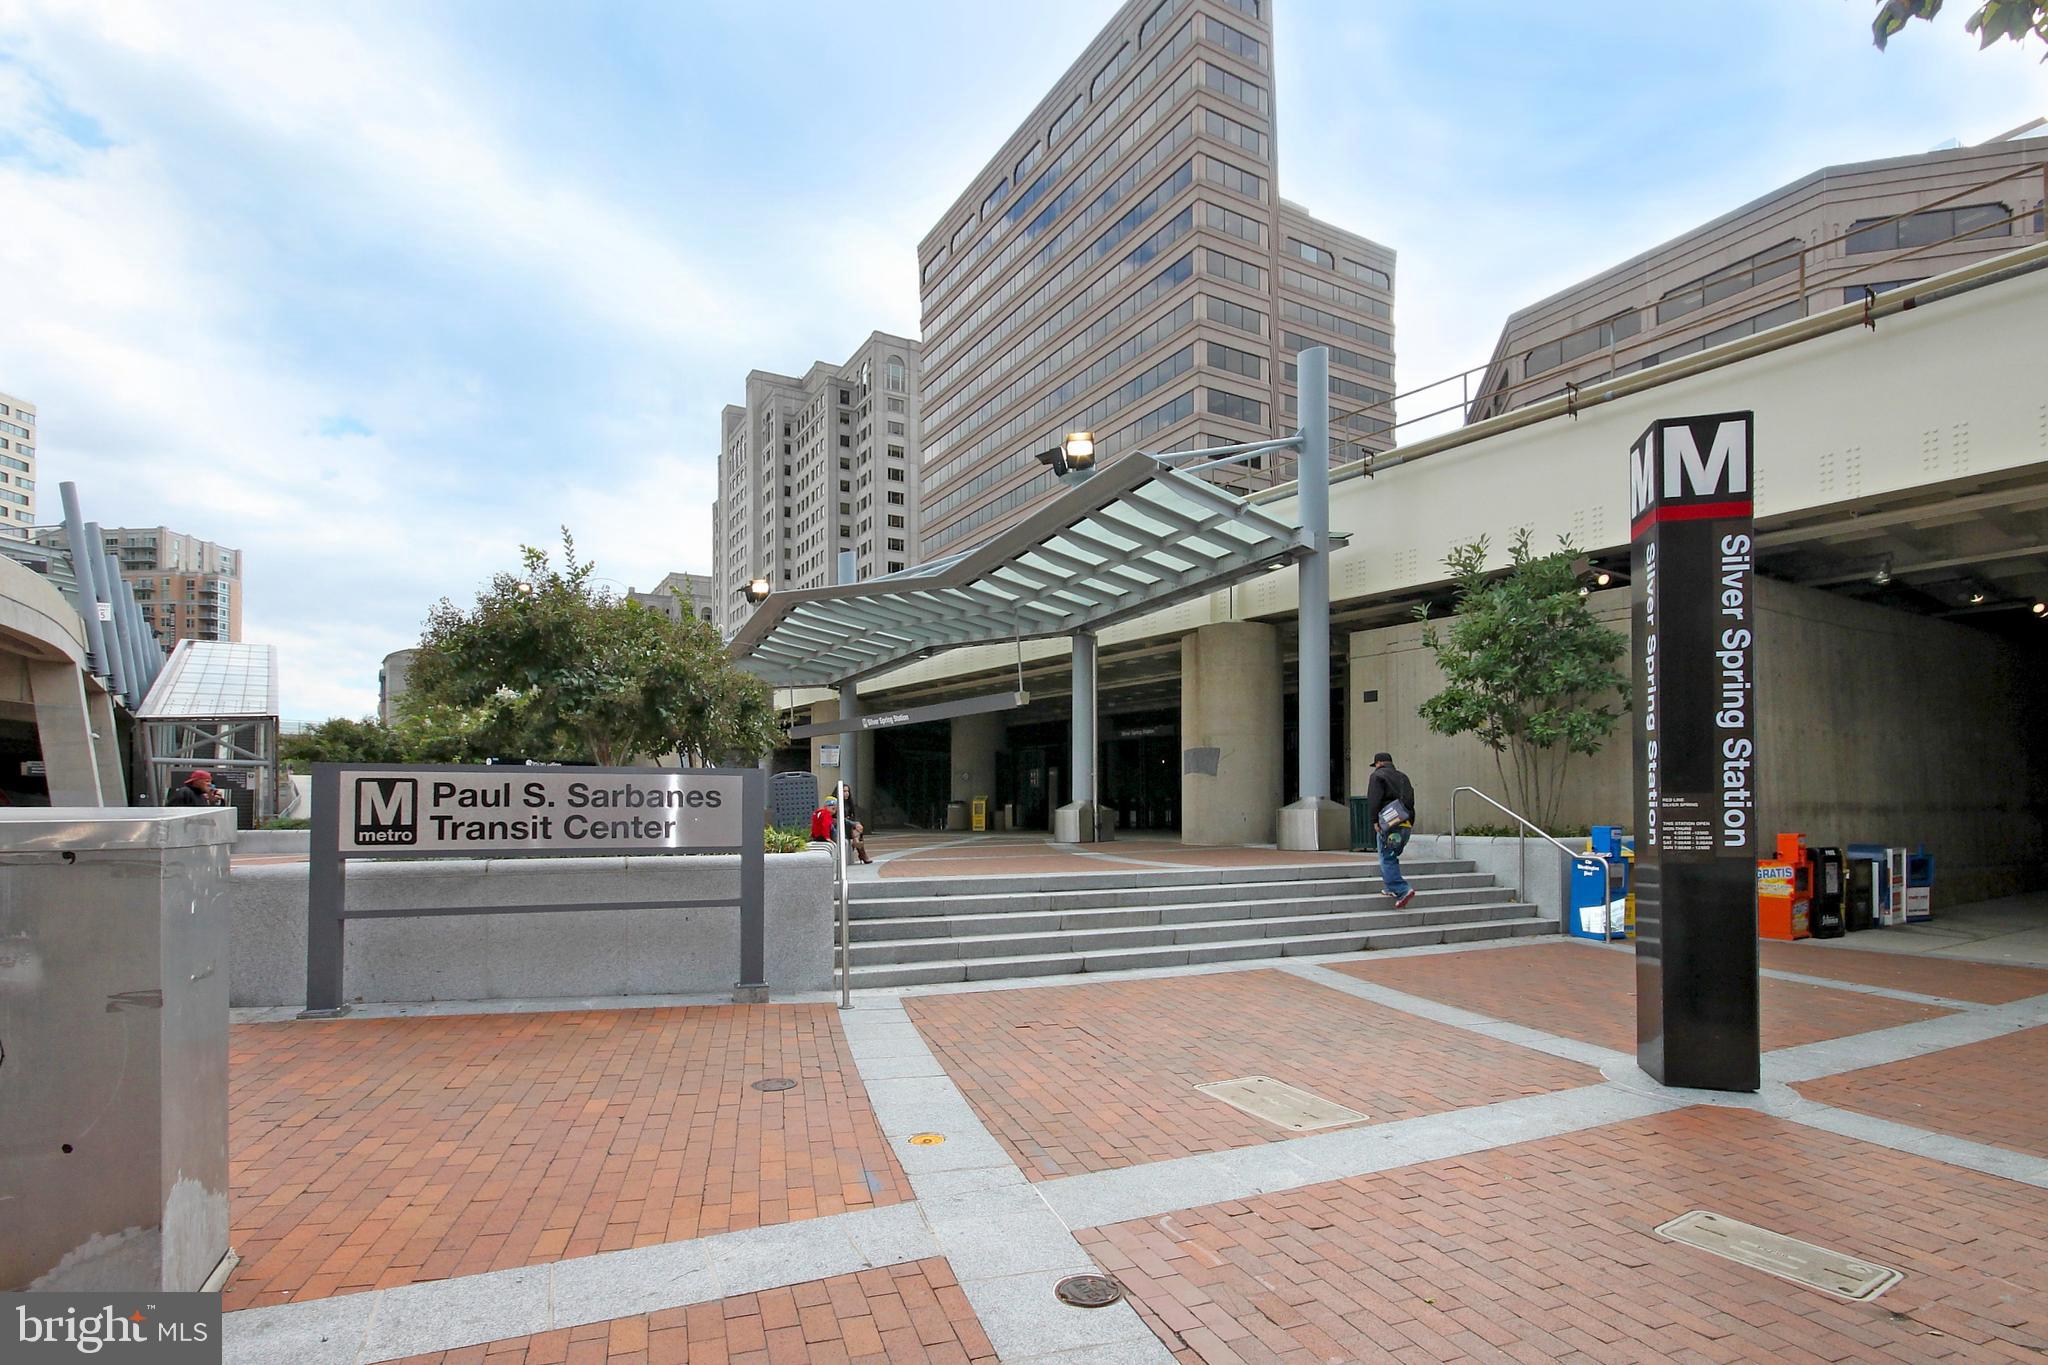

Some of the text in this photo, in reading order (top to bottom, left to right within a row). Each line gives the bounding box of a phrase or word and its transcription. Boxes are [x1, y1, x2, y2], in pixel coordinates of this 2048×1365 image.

[1631, 431, 1654, 520] M
[1663, 420, 1746, 498] M
[1645, 542, 1658, 845] Silver Spring Station
[1716, 534, 1752, 847] Silver Spring Station
[360, 782, 412, 825] M
[433, 782, 722, 808] Paul S. Sarbanes
[359, 829, 412, 842] metro
[430, 815, 676, 839] Transit Center
[1756, 867, 1792, 878] GRATIS
